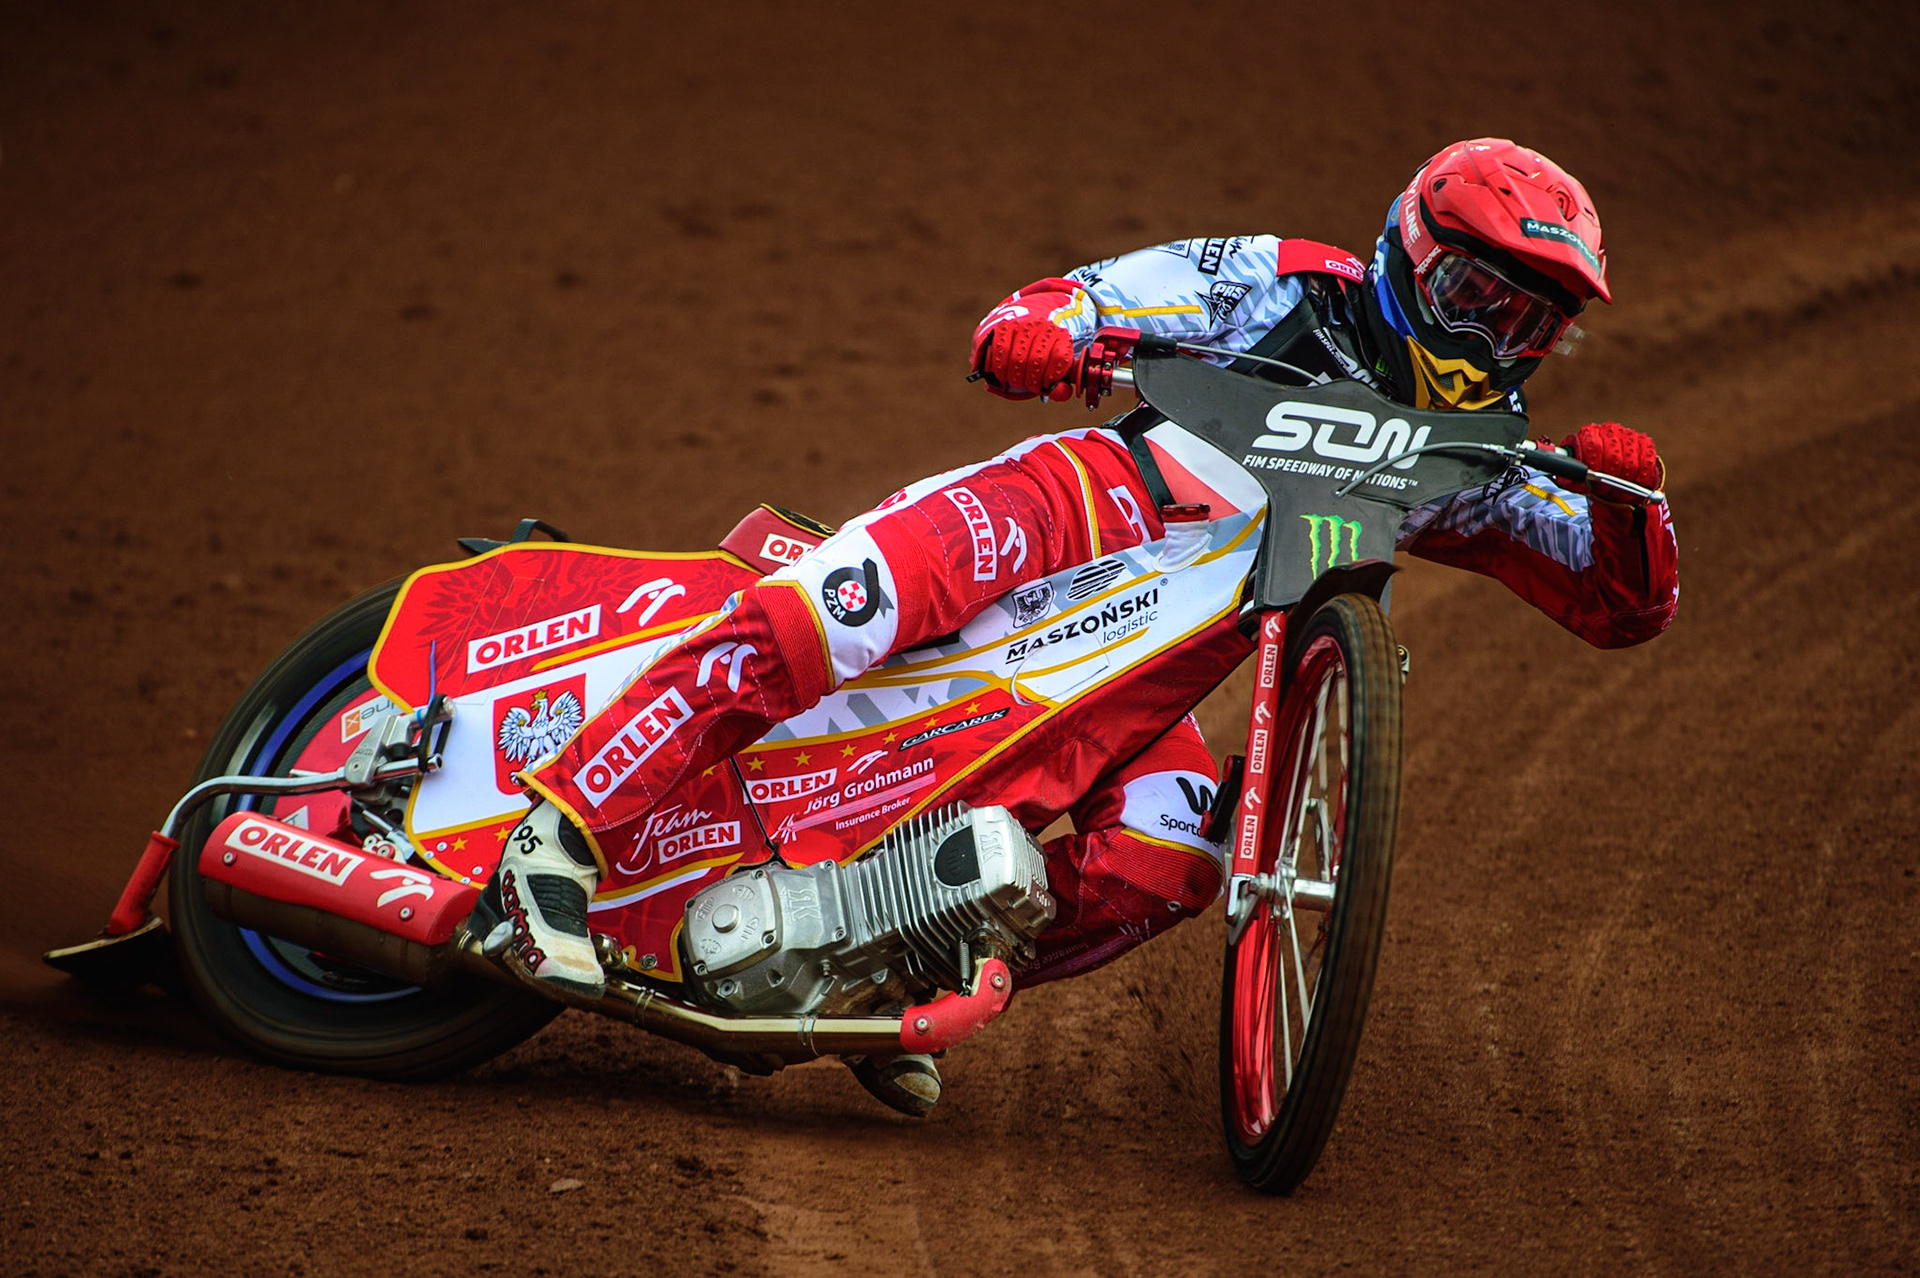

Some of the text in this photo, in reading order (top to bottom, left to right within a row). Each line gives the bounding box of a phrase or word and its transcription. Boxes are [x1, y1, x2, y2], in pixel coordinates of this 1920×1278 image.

[1405, 201, 1421, 243] LINE
[1201, 239, 1223, 272] LEN
[1526, 220, 1600, 267] MASZO
[1327, 260, 1363, 280] ORLE
[1252, 401, 1432, 470] SON
[1242, 454, 1267, 469] FIM
[1266, 457, 1336, 479] SPEEDWAY
[1334, 468, 1354, 482] OF
[768, 540, 812, 562] OR
[951, 486, 997, 580] ORLEN
[823, 588, 847, 620] PZM
[475, 611, 593, 666] ORLEN
[1102, 608, 1158, 644] logistic
[1263, 646, 1276, 686] ORLEN
[585, 696, 684, 797] ORLEN
[902, 709, 1006, 748] GARCAREK
[1253, 732, 1267, 772] ORLEN
[751, 771, 832, 801] ORLEN
[804, 757, 934, 815] Jörg Grohmann
[836, 796, 911, 831] Insurance Broker
[238, 824, 354, 881] ORLEN
[513, 825, 543, 855] 95
[662, 824, 736, 857] ORLEN
[1243, 817, 1257, 857] ORLEN
